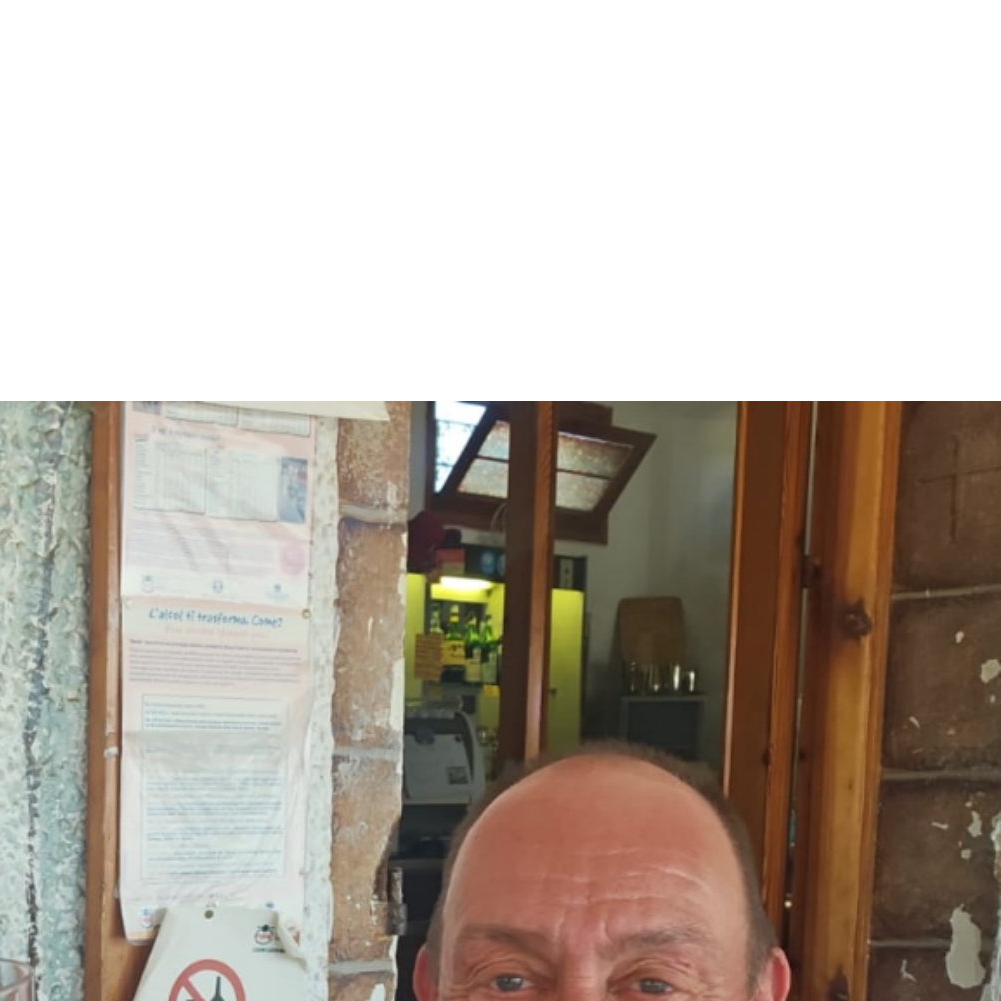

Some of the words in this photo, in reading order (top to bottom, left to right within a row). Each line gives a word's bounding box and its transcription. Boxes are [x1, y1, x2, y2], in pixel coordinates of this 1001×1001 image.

[148, 607, 183, 621] L'alcol
[186, 610, 195, 621] ti
[251, 614, 284, 628] Come?
